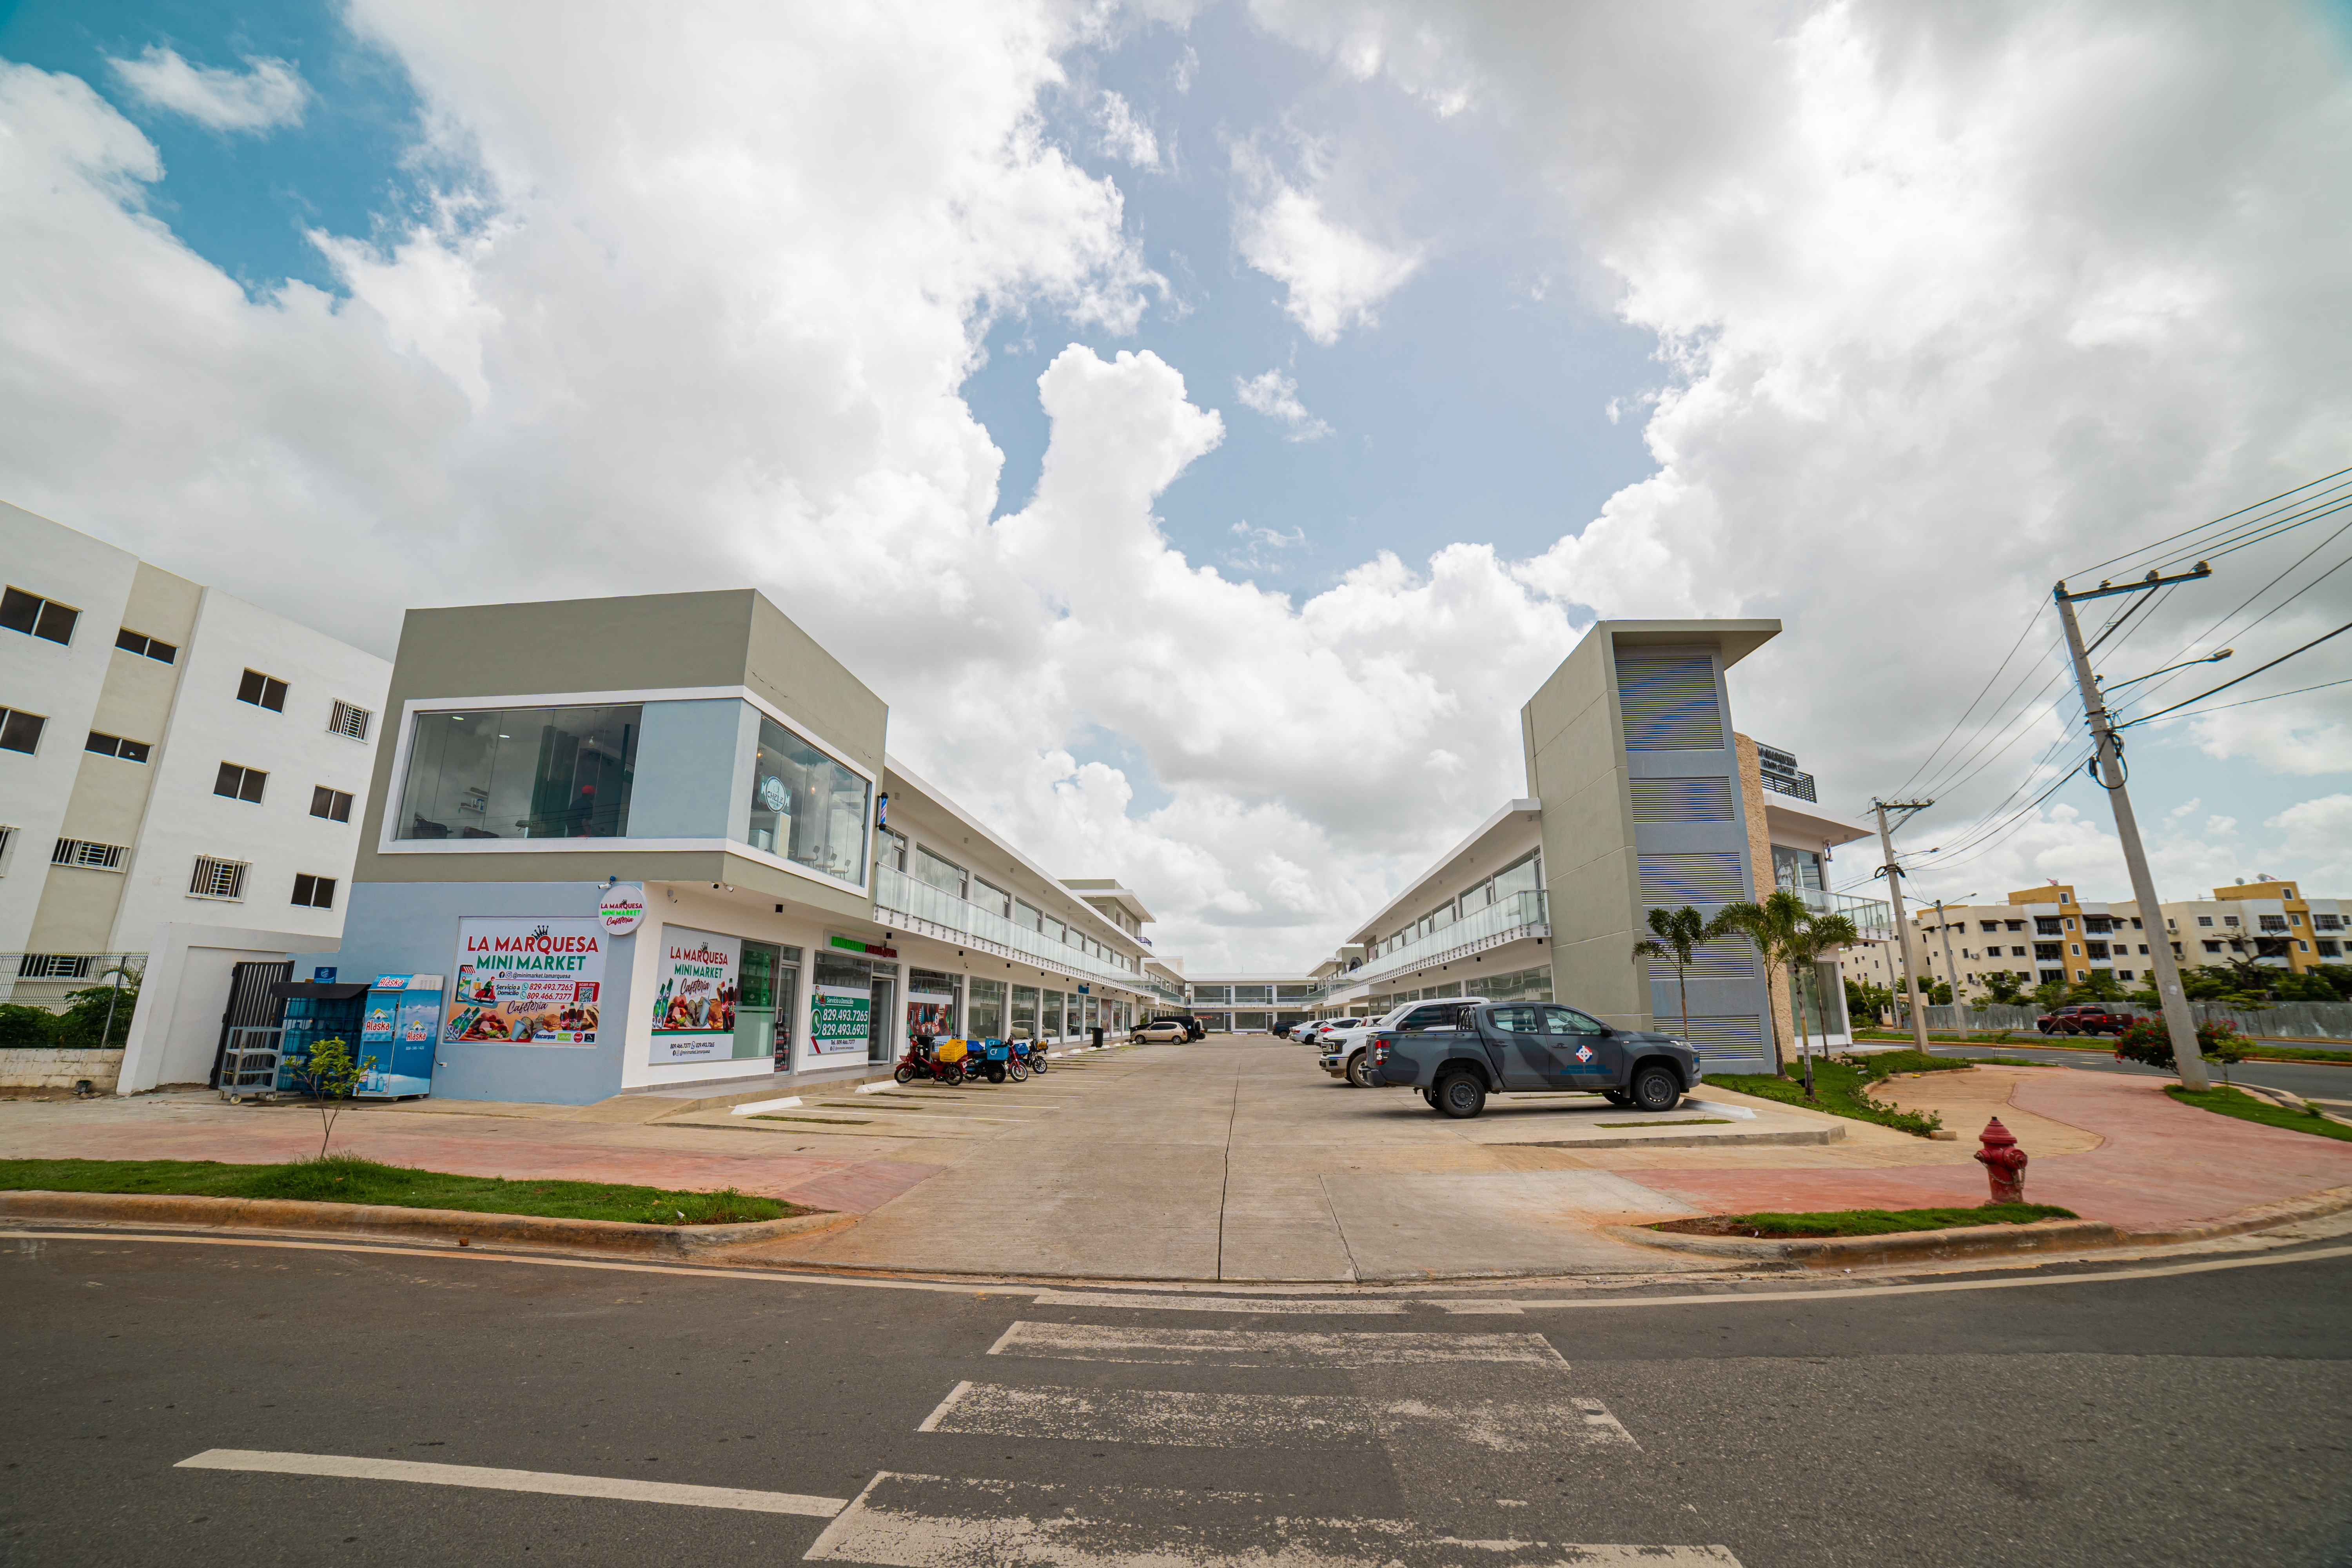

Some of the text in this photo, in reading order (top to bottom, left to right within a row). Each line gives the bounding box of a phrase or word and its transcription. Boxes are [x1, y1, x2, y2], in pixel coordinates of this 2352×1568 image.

[1766, 749, 1798, 767] MARQUESA
[1762, 759, 1795, 776] TOWN CENTER
[606, 916, 634, 926] Cafeteria
[467, 935, 599, 955] LA MARQUESA
[832, 936, 897, 958] MINI MARKET LA MARQUESA
[476, 955, 586, 971] MINI MARKET
[670, 946, 728, 965] LA MARQUESA
[674, 963, 723, 978] MINI MARKET
[378, 976, 403, 987] Alaska
[680, 978, 710, 996] Cafeteria
[507, 1000, 548, 1014] Cafeteria
[823, 1009, 868, 1022] 829.493.7265
[366, 1020, 390, 1031] Alaska
[822, 1023, 867, 1036] 829.493.6931
[407, 1031, 426, 1041] Alaska
